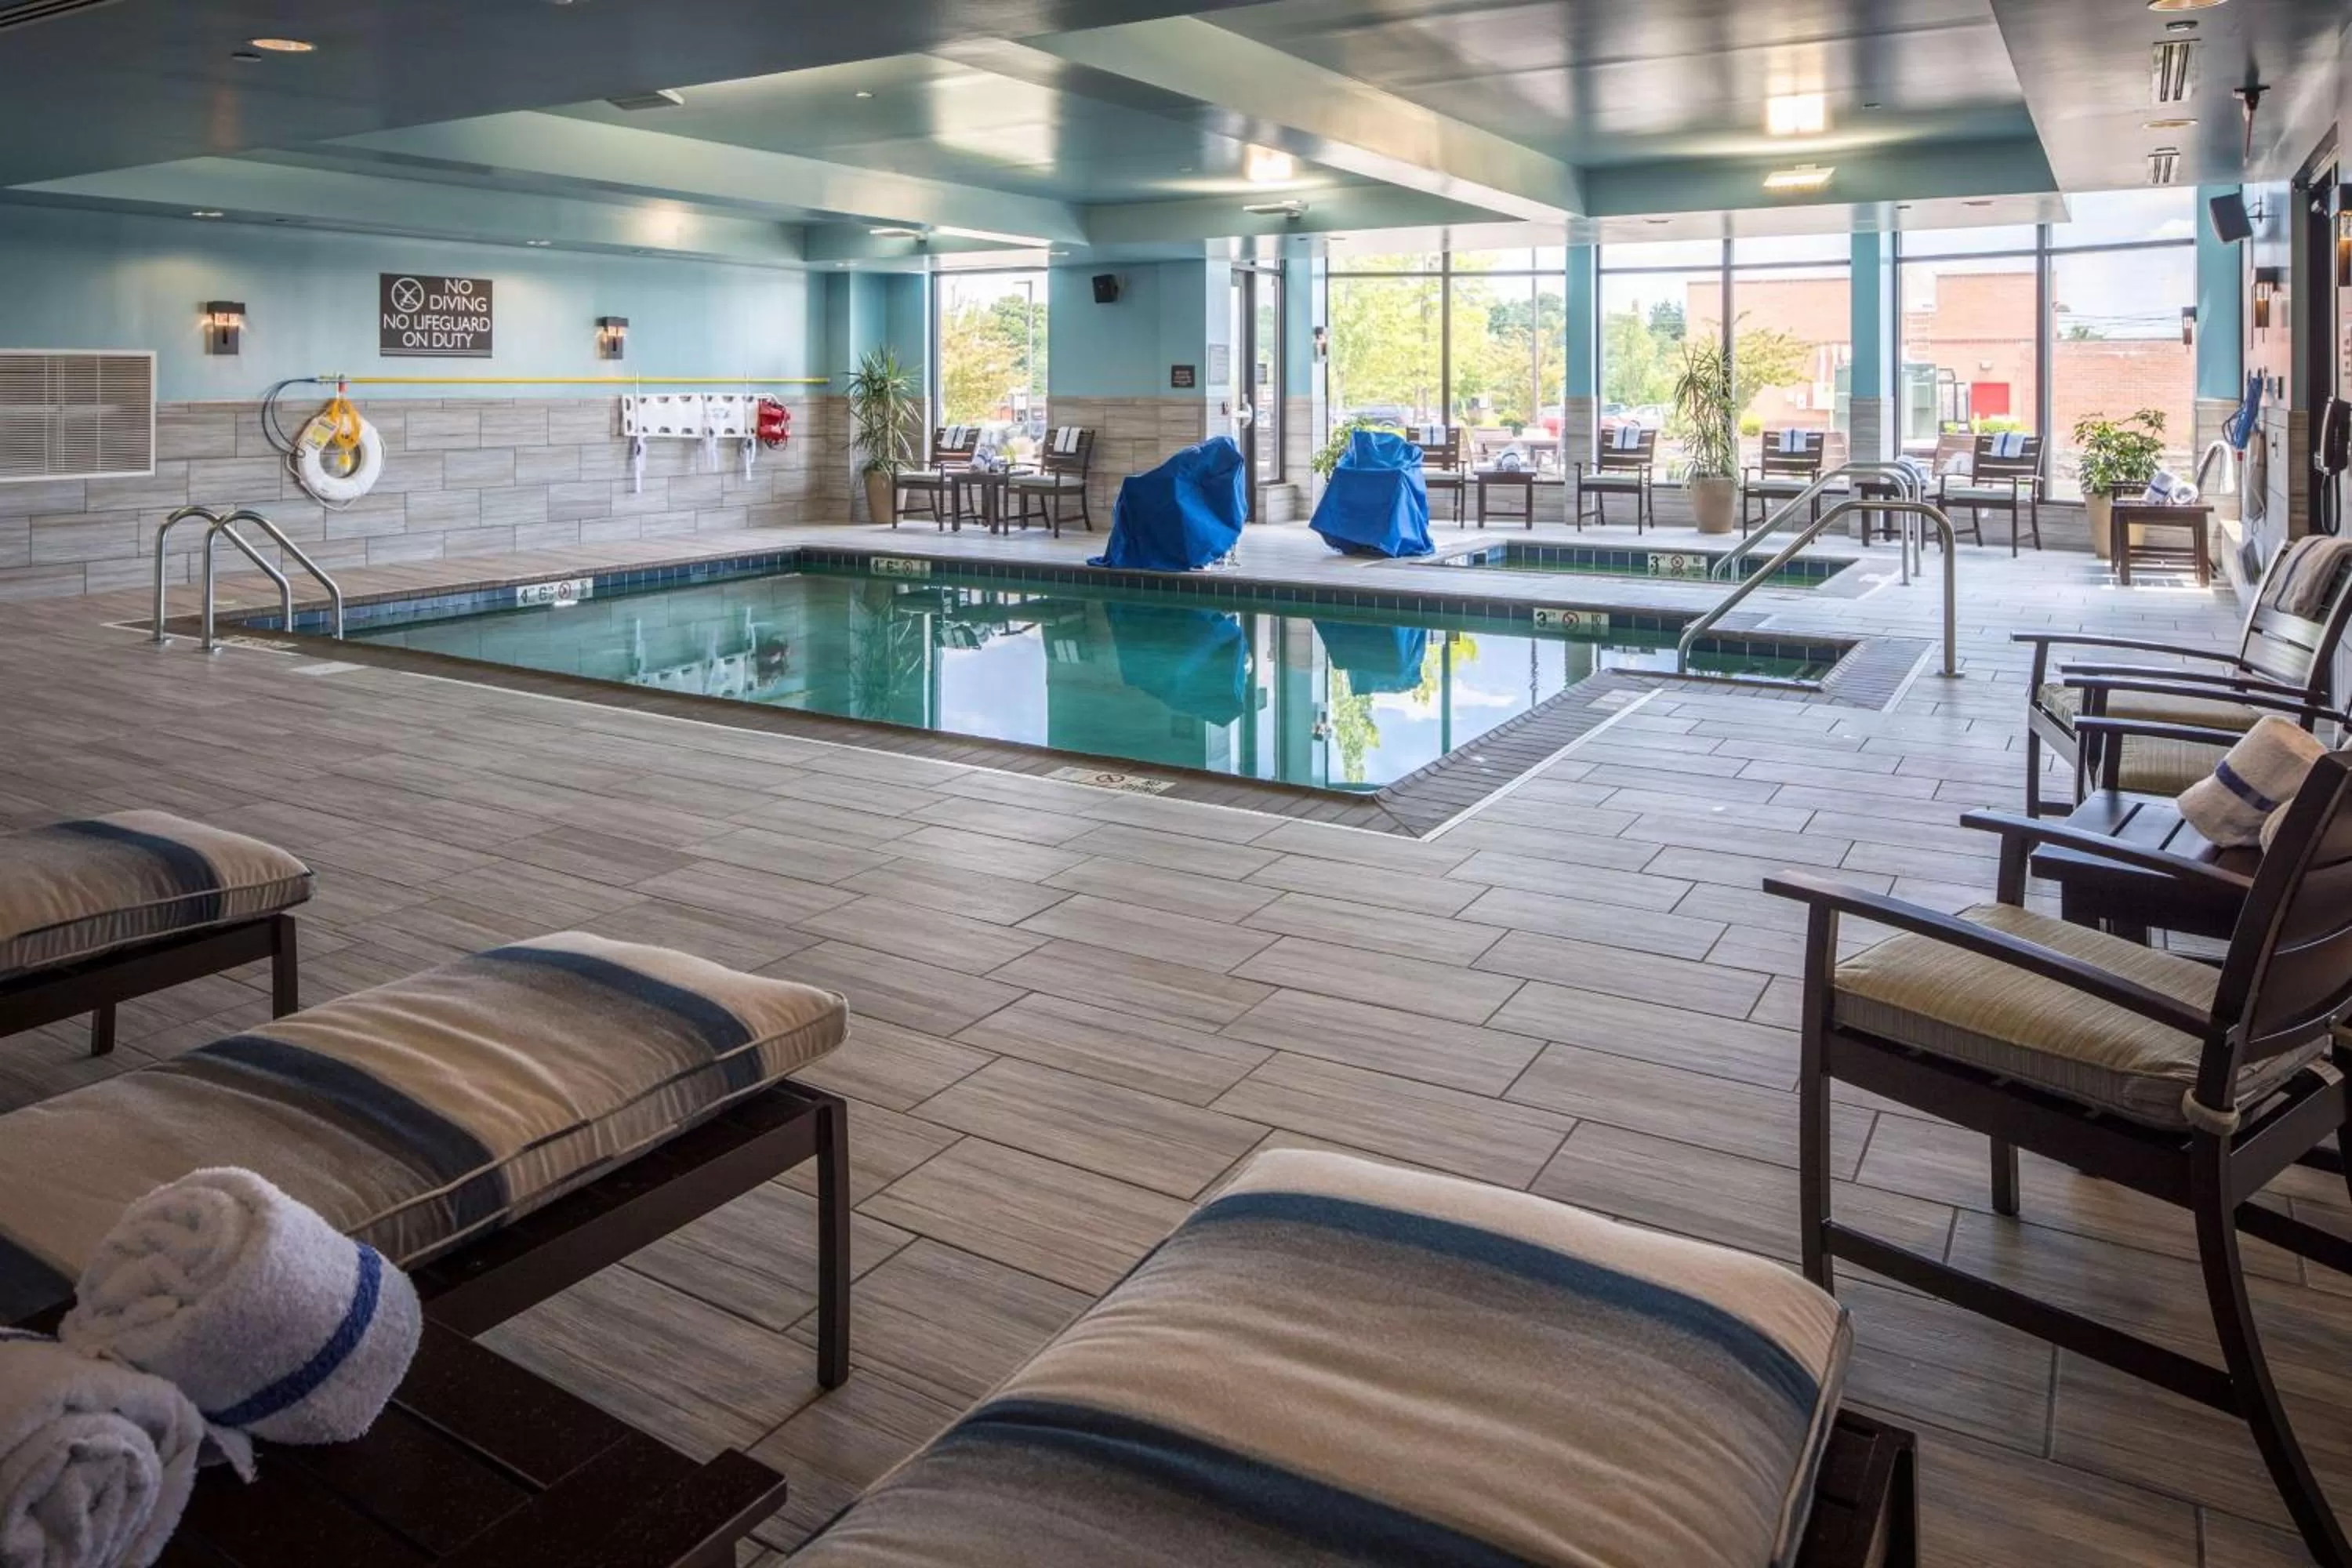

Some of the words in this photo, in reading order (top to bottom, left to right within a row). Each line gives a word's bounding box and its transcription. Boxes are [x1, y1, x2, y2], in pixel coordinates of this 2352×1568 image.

[445, 278, 473, 295] NO
[429, 295, 488, 312] DIVING
[383, 314, 410, 329] NO
[413, 315, 491, 332] LIFEGUARD
[402, 332, 429, 347] ON
[432, 332, 474, 348] DUTY
